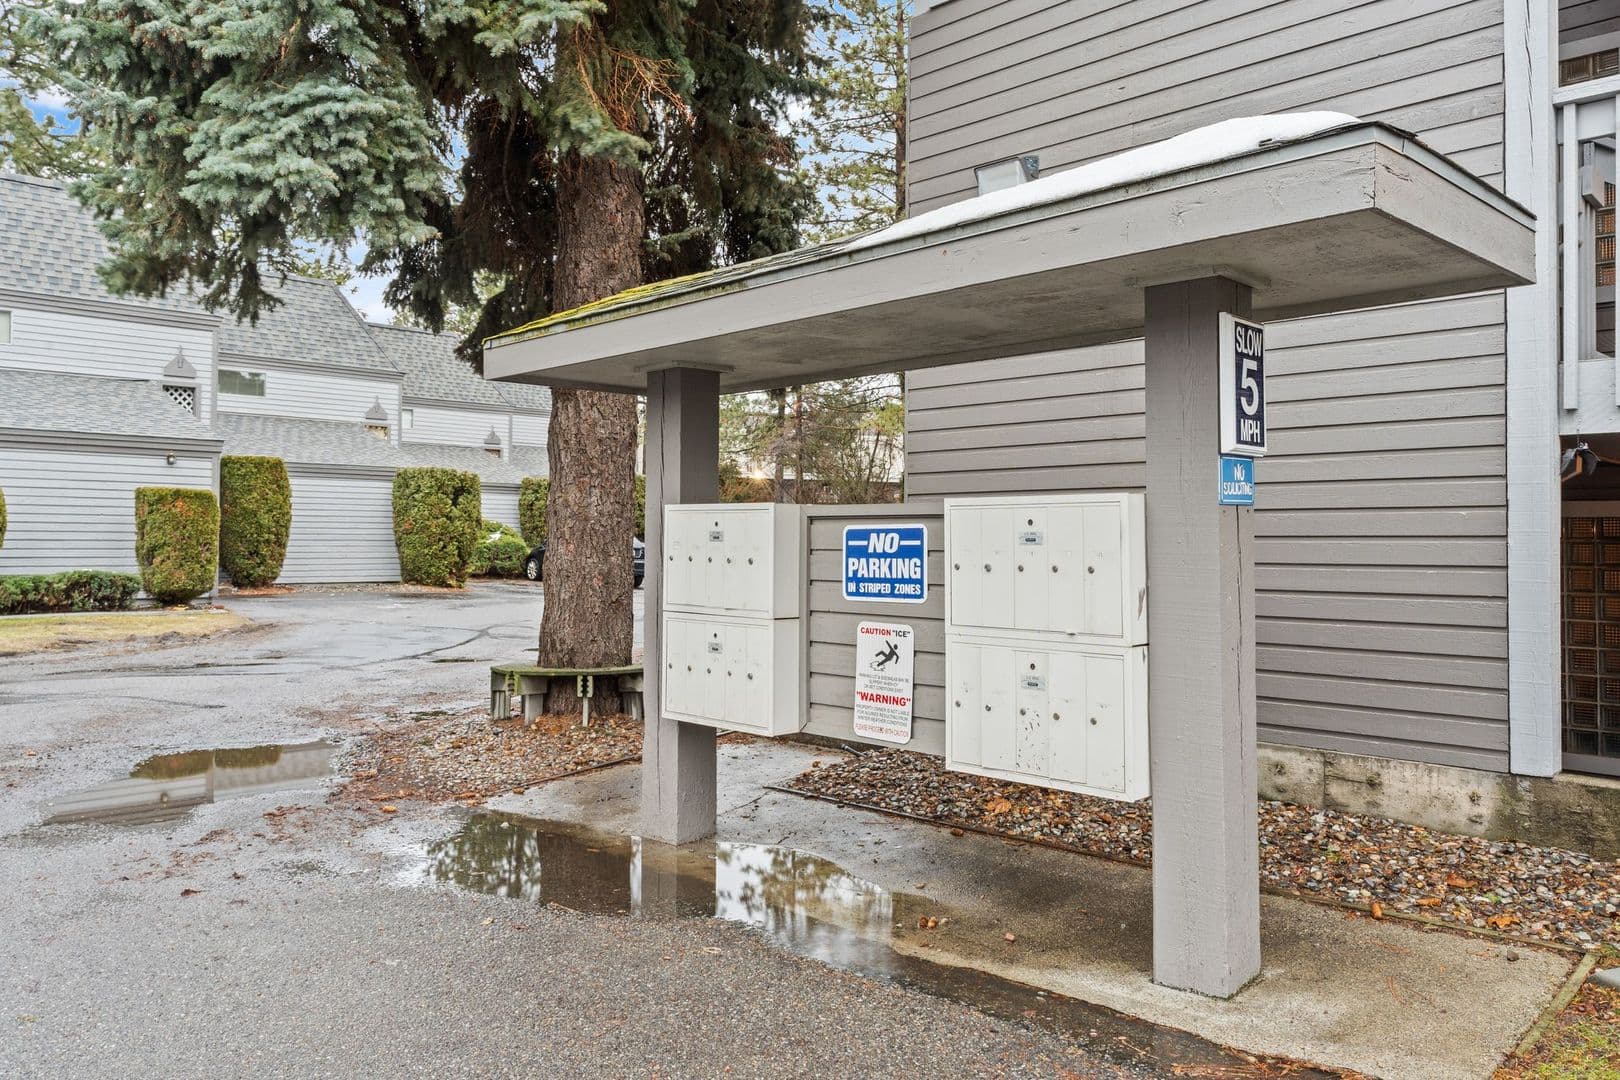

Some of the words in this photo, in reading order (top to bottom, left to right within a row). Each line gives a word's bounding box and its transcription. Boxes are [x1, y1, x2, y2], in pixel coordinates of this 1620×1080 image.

[1235, 325, 1262, 357] SLOW
[1240, 358, 1259, 416] 5
[1240, 418, 1261, 443] MPH
[1234, 463, 1245, 481] NO
[868, 532, 900, 554] NO
[847, 557, 921, 579] PARKING
[847, 582, 856, 593] IN
[859, 582, 891, 594] STRIPED
[894, 583, 921, 595] ZONES
[860, 626, 892, 637] CAUTION
[856, 691, 911, 708] "WARNING"
